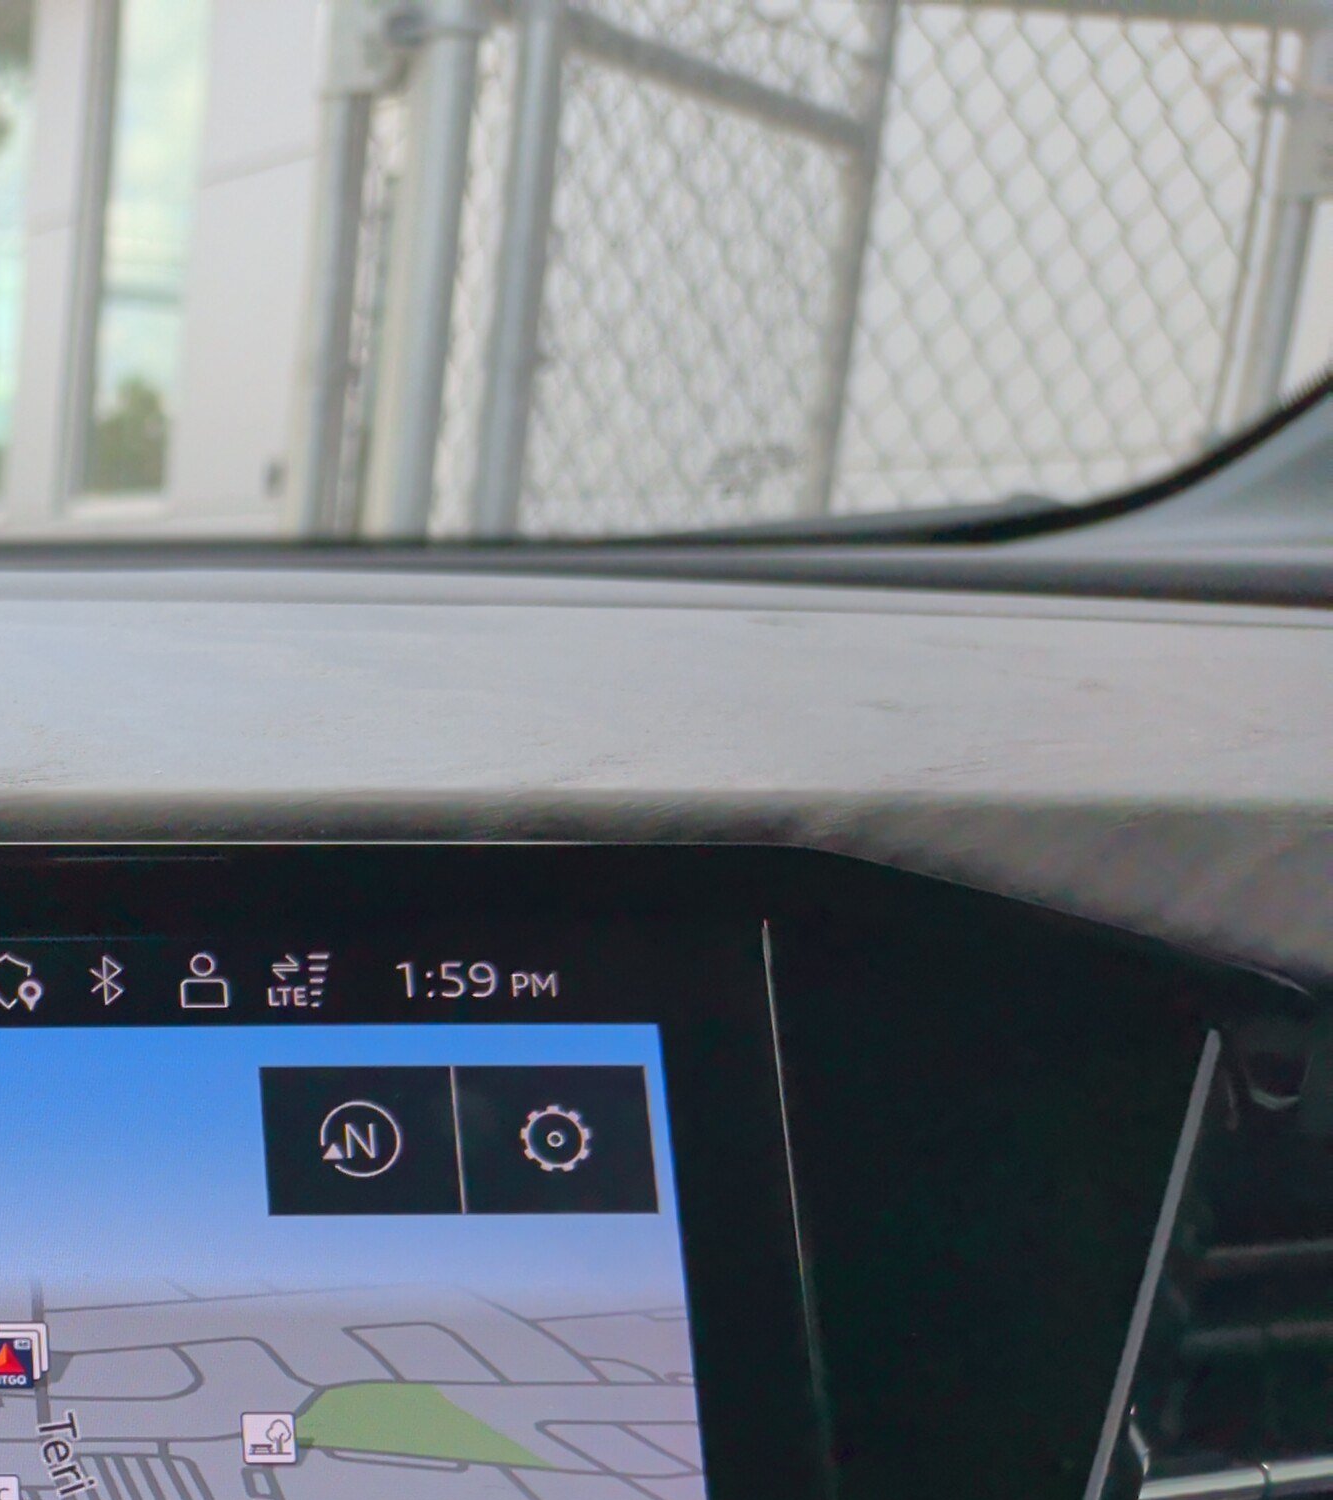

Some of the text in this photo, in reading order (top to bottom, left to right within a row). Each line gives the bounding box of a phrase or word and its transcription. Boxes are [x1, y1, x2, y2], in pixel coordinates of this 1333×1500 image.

[268, 986, 308, 1007] LTE
[395, 960, 559, 999] 1:59 PM
[345, 1123, 377, 1159] N
[38, 1412, 96, 1496] Teri
